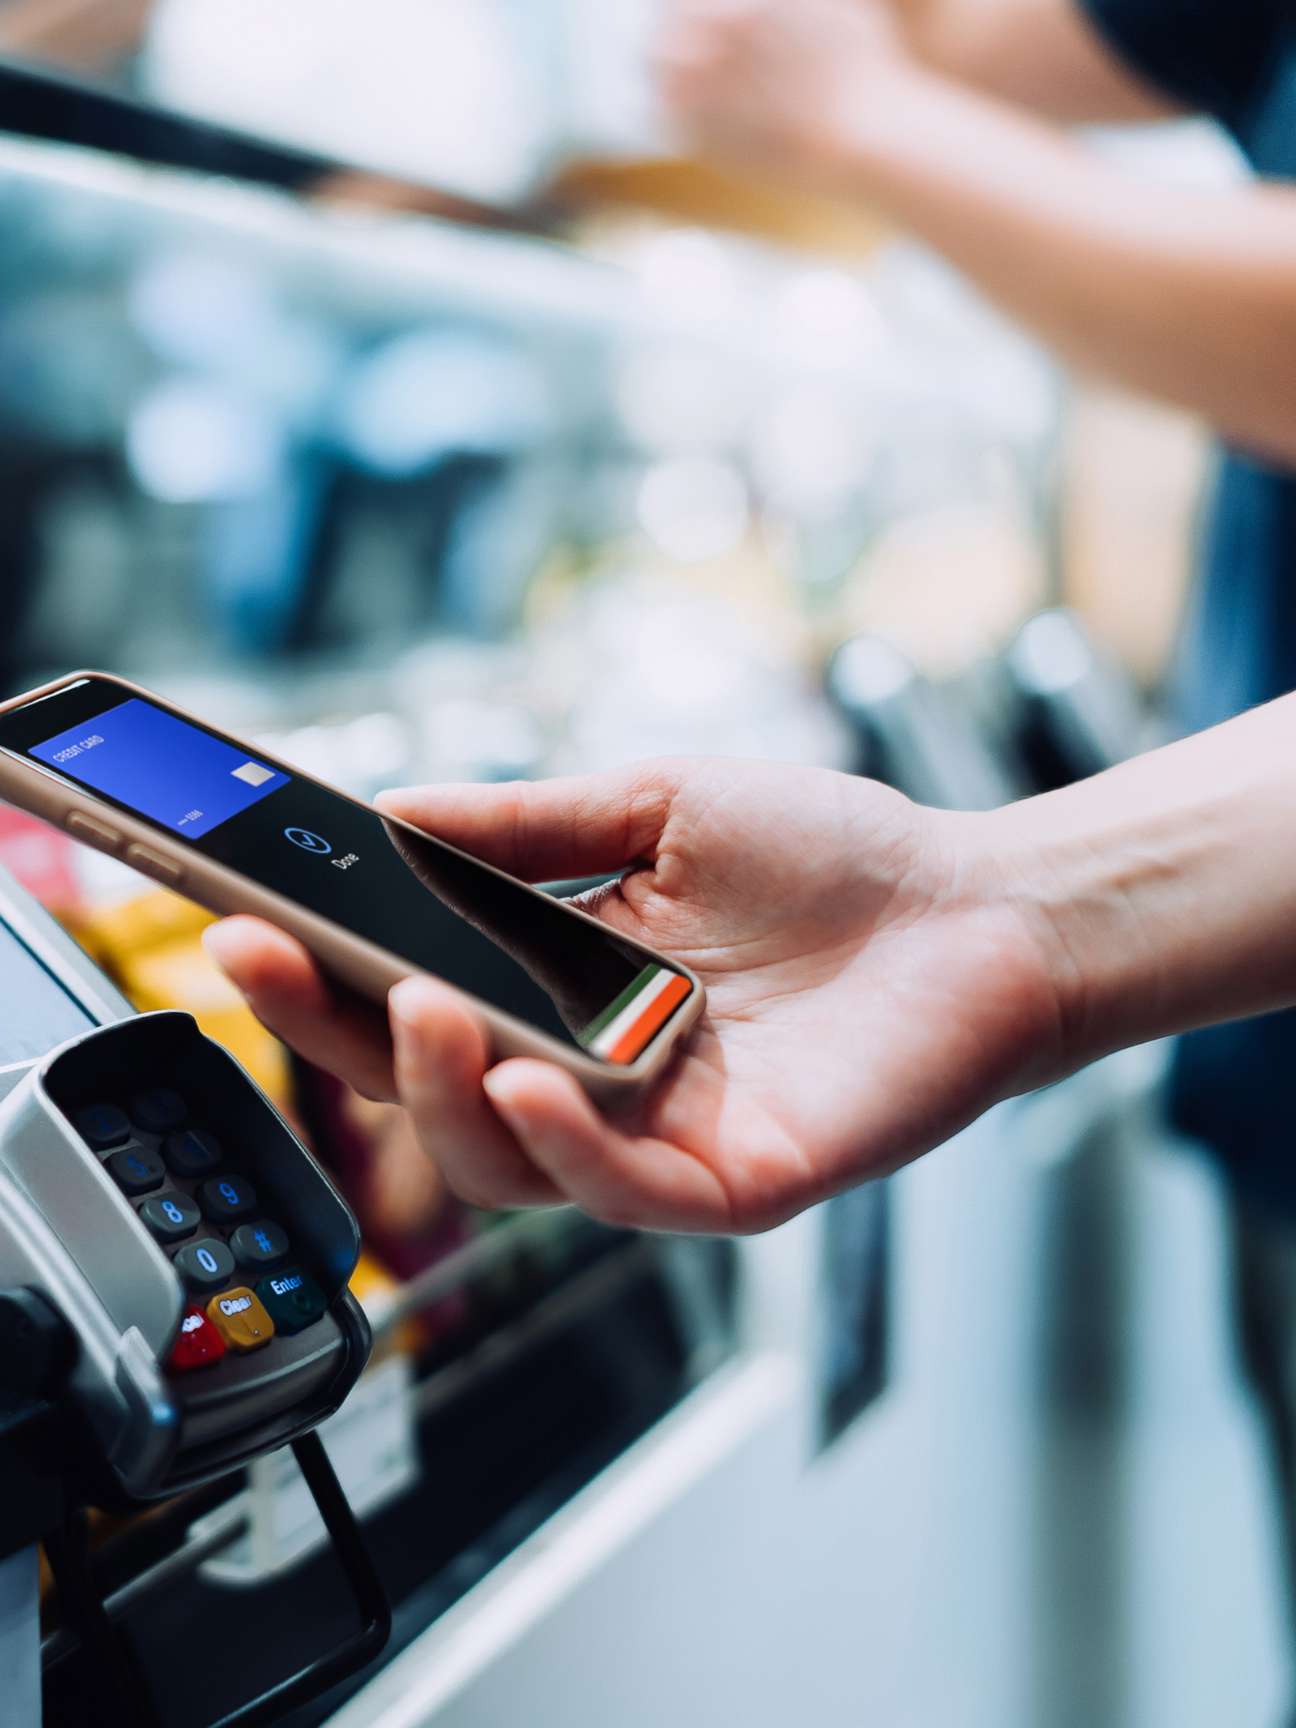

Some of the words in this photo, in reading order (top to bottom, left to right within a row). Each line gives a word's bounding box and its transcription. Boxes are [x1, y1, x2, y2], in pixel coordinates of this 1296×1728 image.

[53, 744, 85, 762] CREDIT
[79, 735, 105, 750] CARD
[330, 853, 360, 870] Done
[219, 1183, 240, 1205] 9
[160, 1200, 183, 1223] 8
[253, 1229, 273, 1251] #
[196, 1247, 218, 1272] 0
[270, 1274, 305, 1296] Enter
[219, 1295, 252, 1316] Clear
